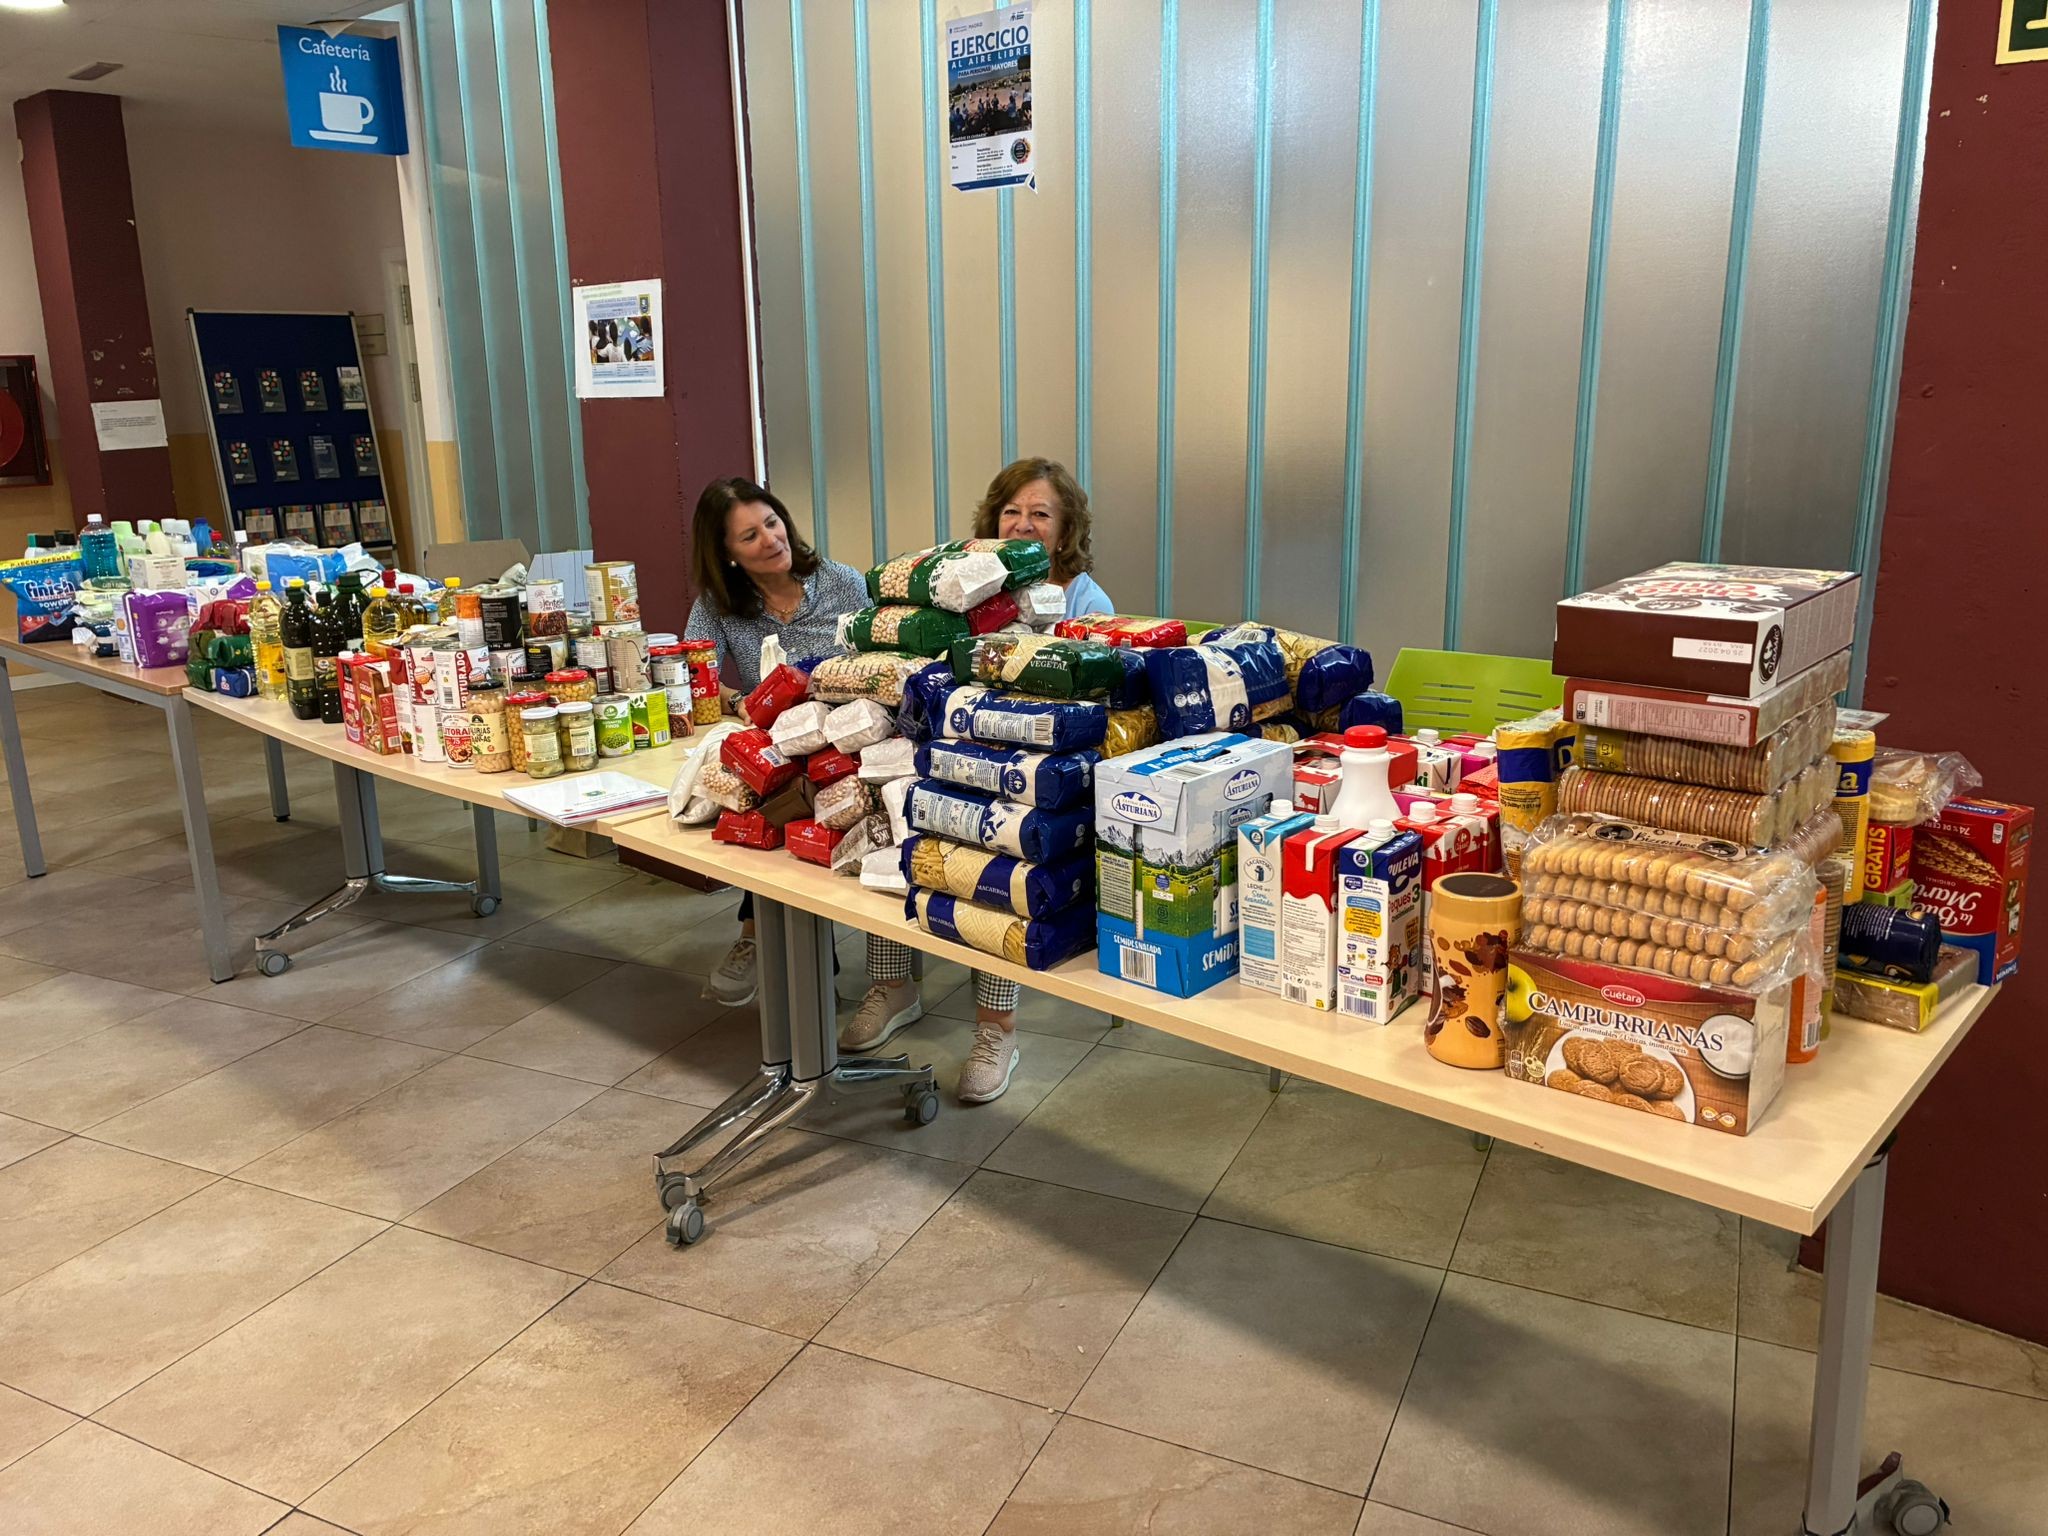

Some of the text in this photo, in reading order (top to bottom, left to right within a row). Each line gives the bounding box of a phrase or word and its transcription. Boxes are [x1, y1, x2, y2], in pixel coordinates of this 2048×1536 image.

[299, 37, 370, 61] Cafetería
[951, 25, 1029, 59] EJERCICIO
[951, 46, 1029, 70] AL AIRE LIBRE
[991, 59, 1018, 71] MAYORES
[24, 577, 75, 598] finish
[39, 600, 69, 608] POWER
[1030, 660, 1068, 671] VEGETAL
[456, 651, 468, 710] TRITURADO
[1226, 780, 1259, 797] ASTURIANA
[1116, 800, 1158, 818] ASTURIANA
[1959, 827, 1971, 836] 74
[1388, 852, 1419, 877] PULEVA
[1864, 827, 1887, 889] GRATIS
[1925, 876, 1956, 887] ORIGINAL
[977, 885, 1009, 897] MACARRÓN
[1412, 883, 1421, 903] 3
[929, 915, 955, 930] MACARRÓN
[1960, 912, 1974, 926] la
[1350, 974, 1364, 982] Club
[1603, 988, 1642, 1004] Cuétara
[1528, 991, 1724, 1052] CAMPURRIANAS
